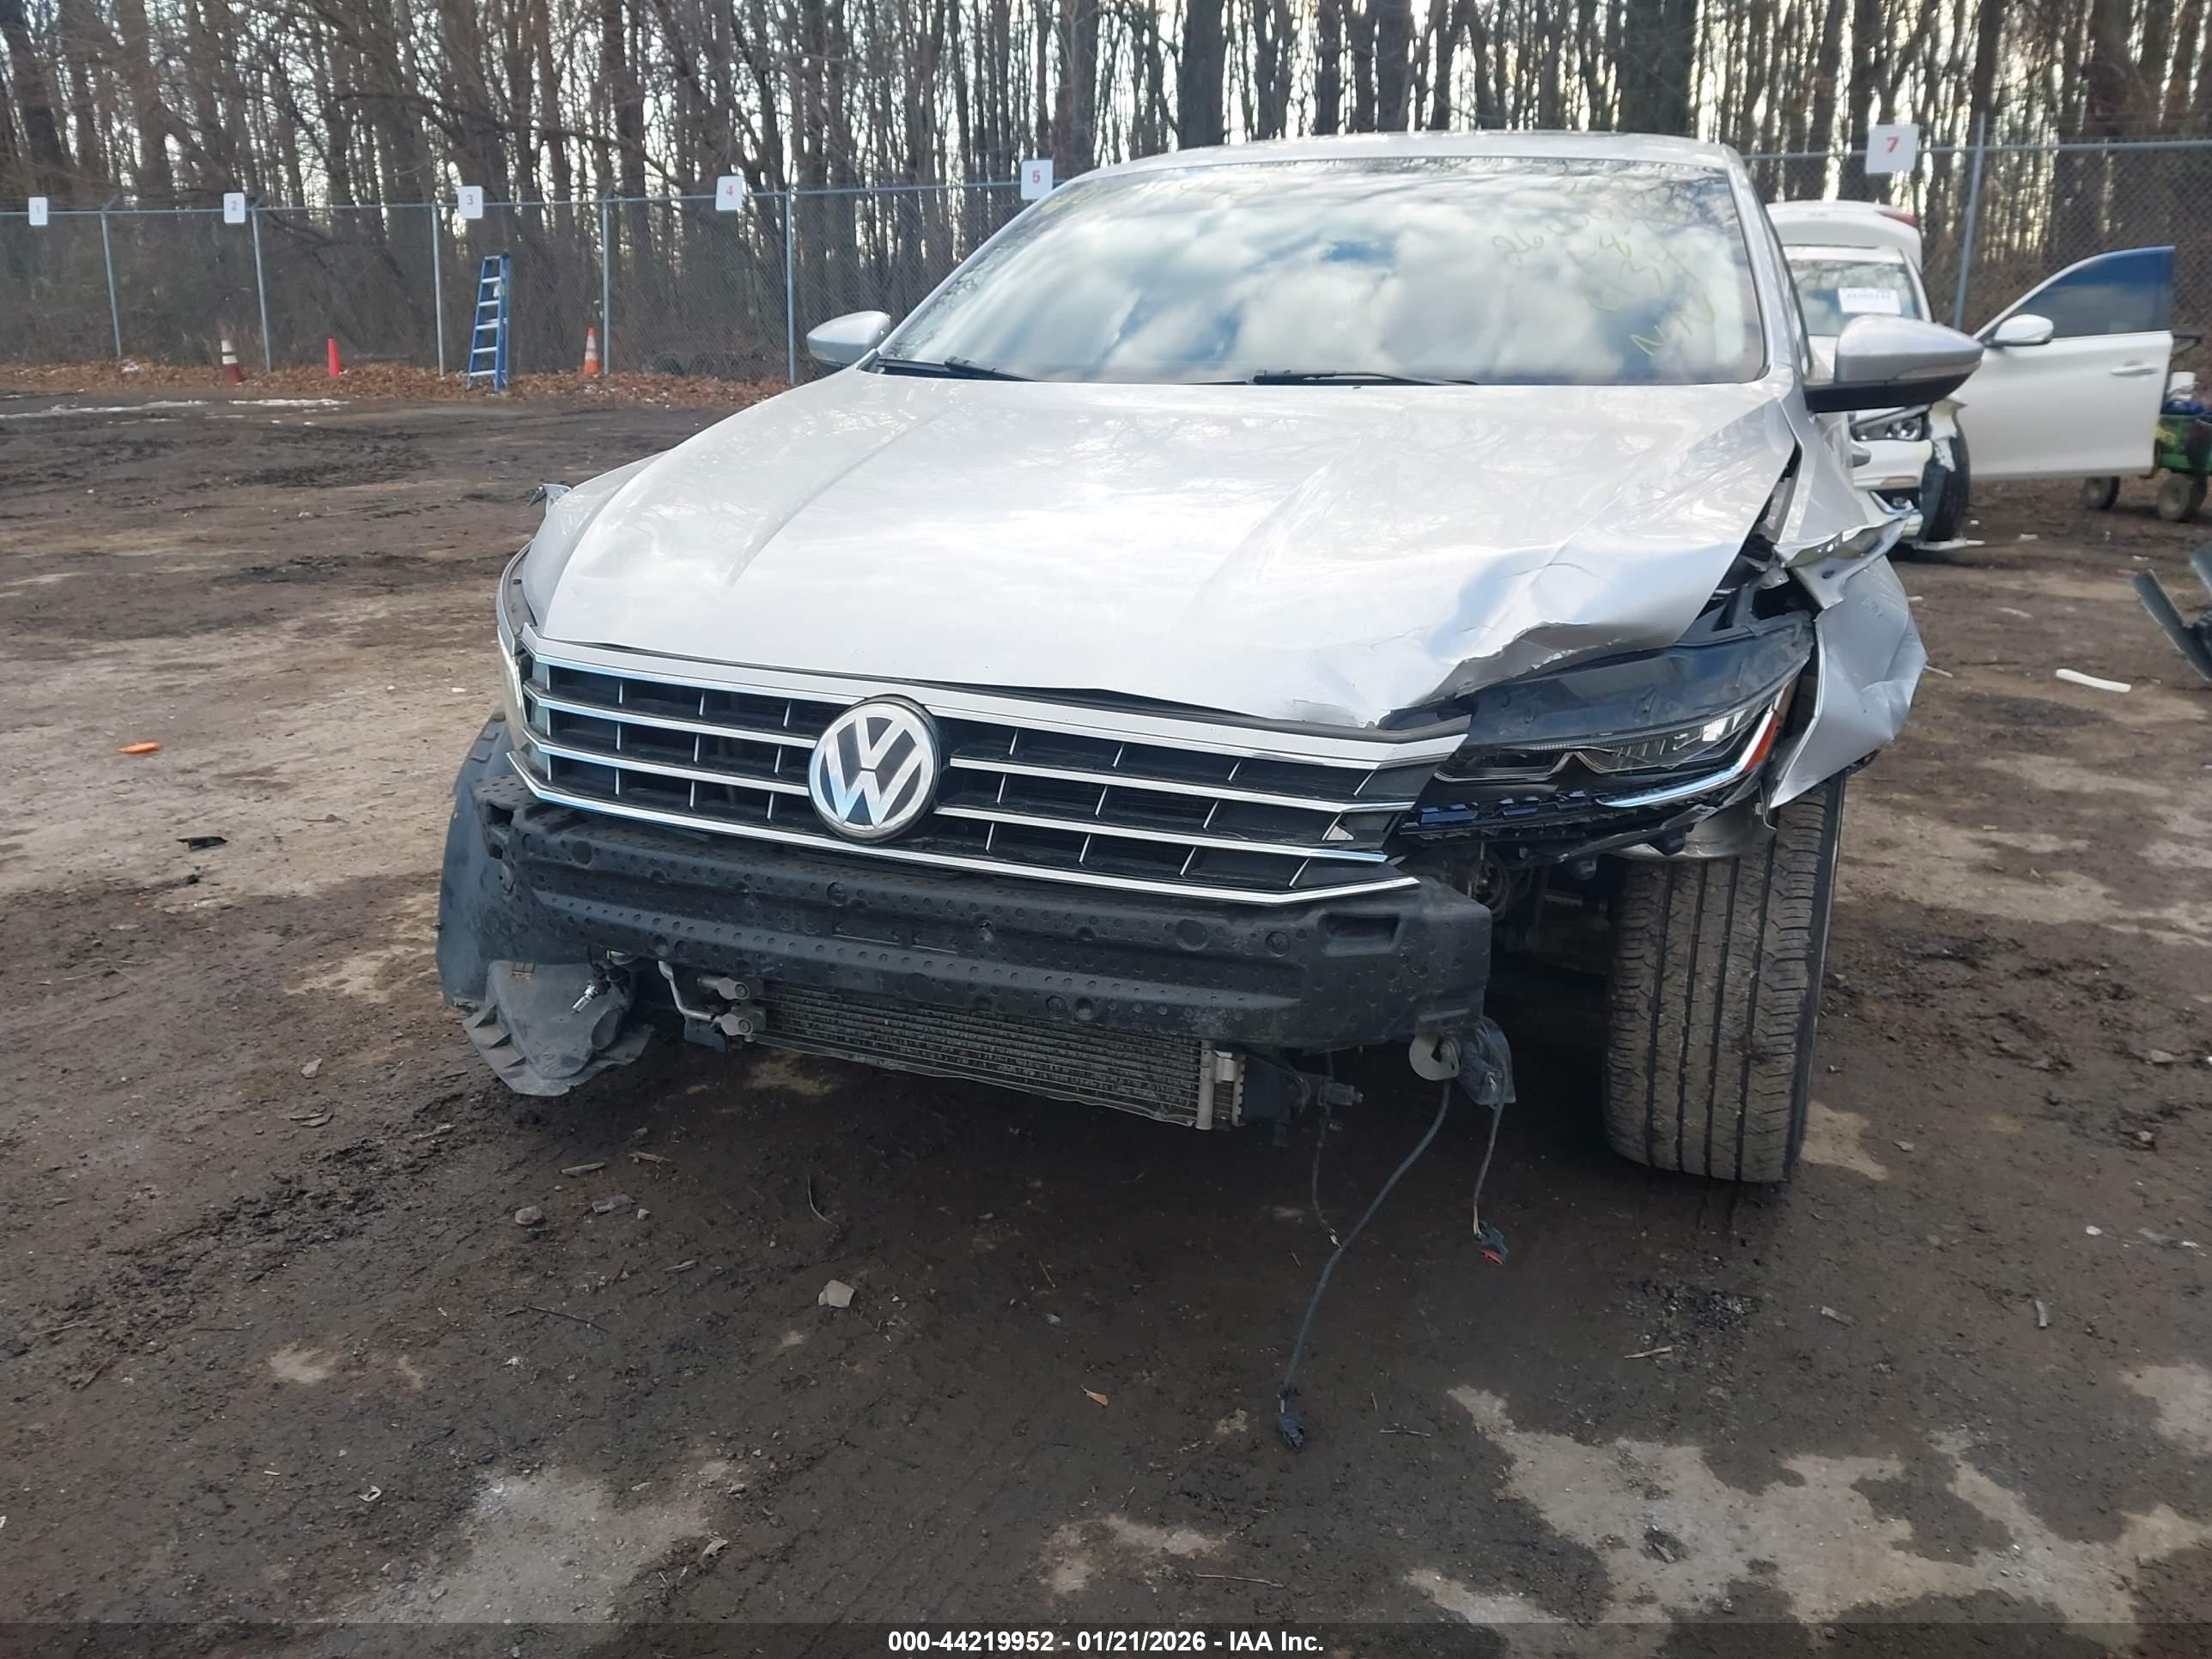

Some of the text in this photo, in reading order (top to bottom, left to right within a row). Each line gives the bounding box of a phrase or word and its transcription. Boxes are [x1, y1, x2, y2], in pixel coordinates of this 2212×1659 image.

[1887, 137, 1899, 152] 7
[1032, 170, 1041, 183] 5
[726, 185, 733, 196] 4
[466, 194, 473, 206] 3
[810, 702, 934, 833] VW
